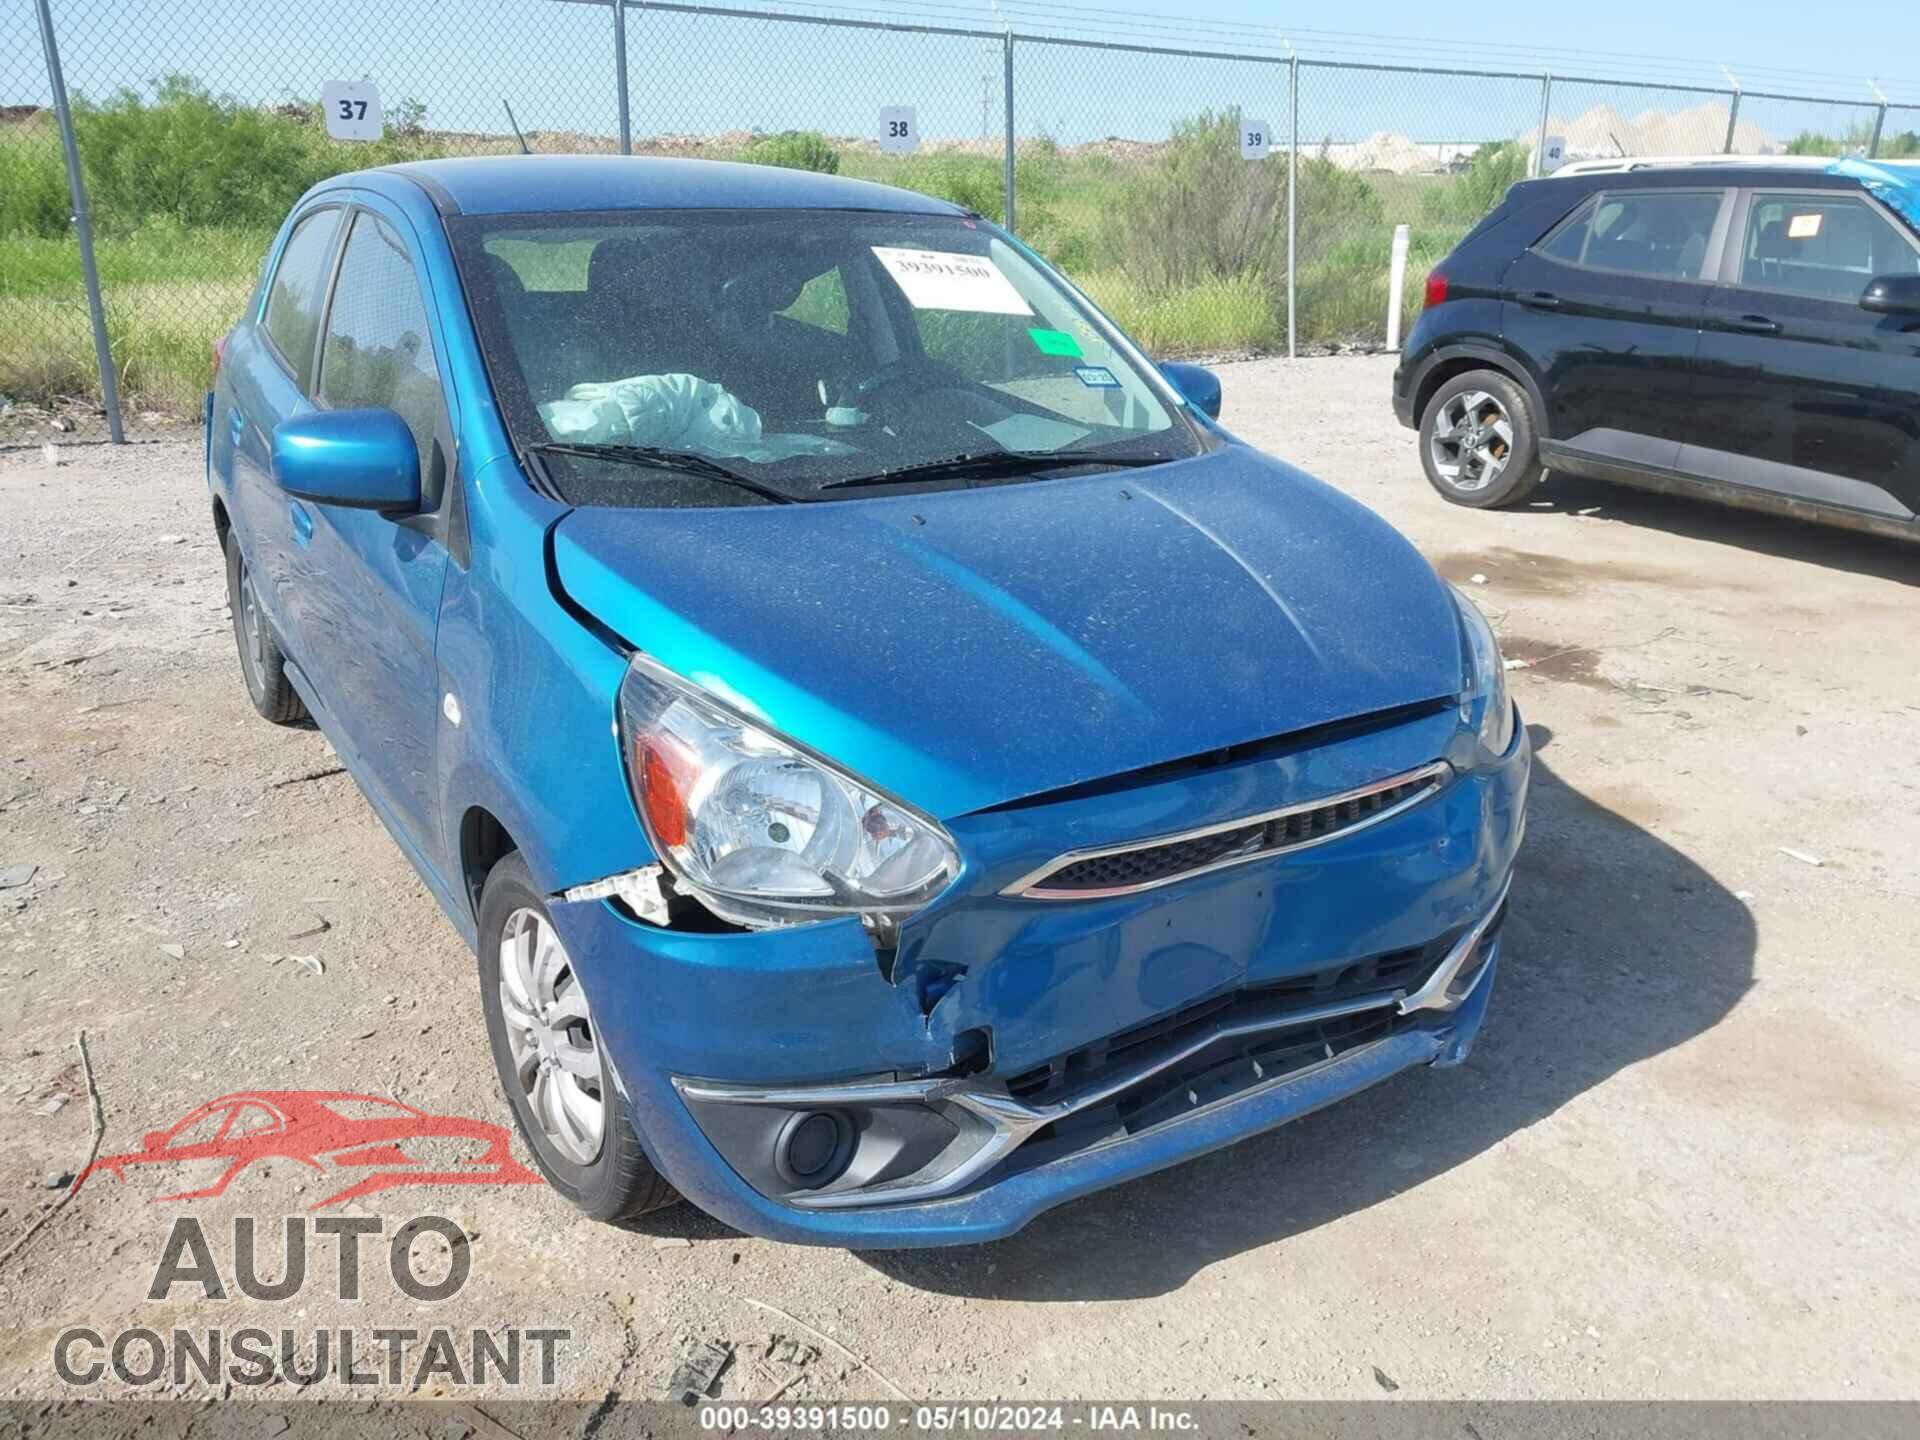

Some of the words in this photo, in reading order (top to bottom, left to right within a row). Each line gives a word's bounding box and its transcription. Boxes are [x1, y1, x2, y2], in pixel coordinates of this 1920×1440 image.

[339, 100, 368, 120] 37
[889, 121, 908, 137] 38
[1247, 132, 1262, 147] 39
[1548, 147, 1560, 159] 40
